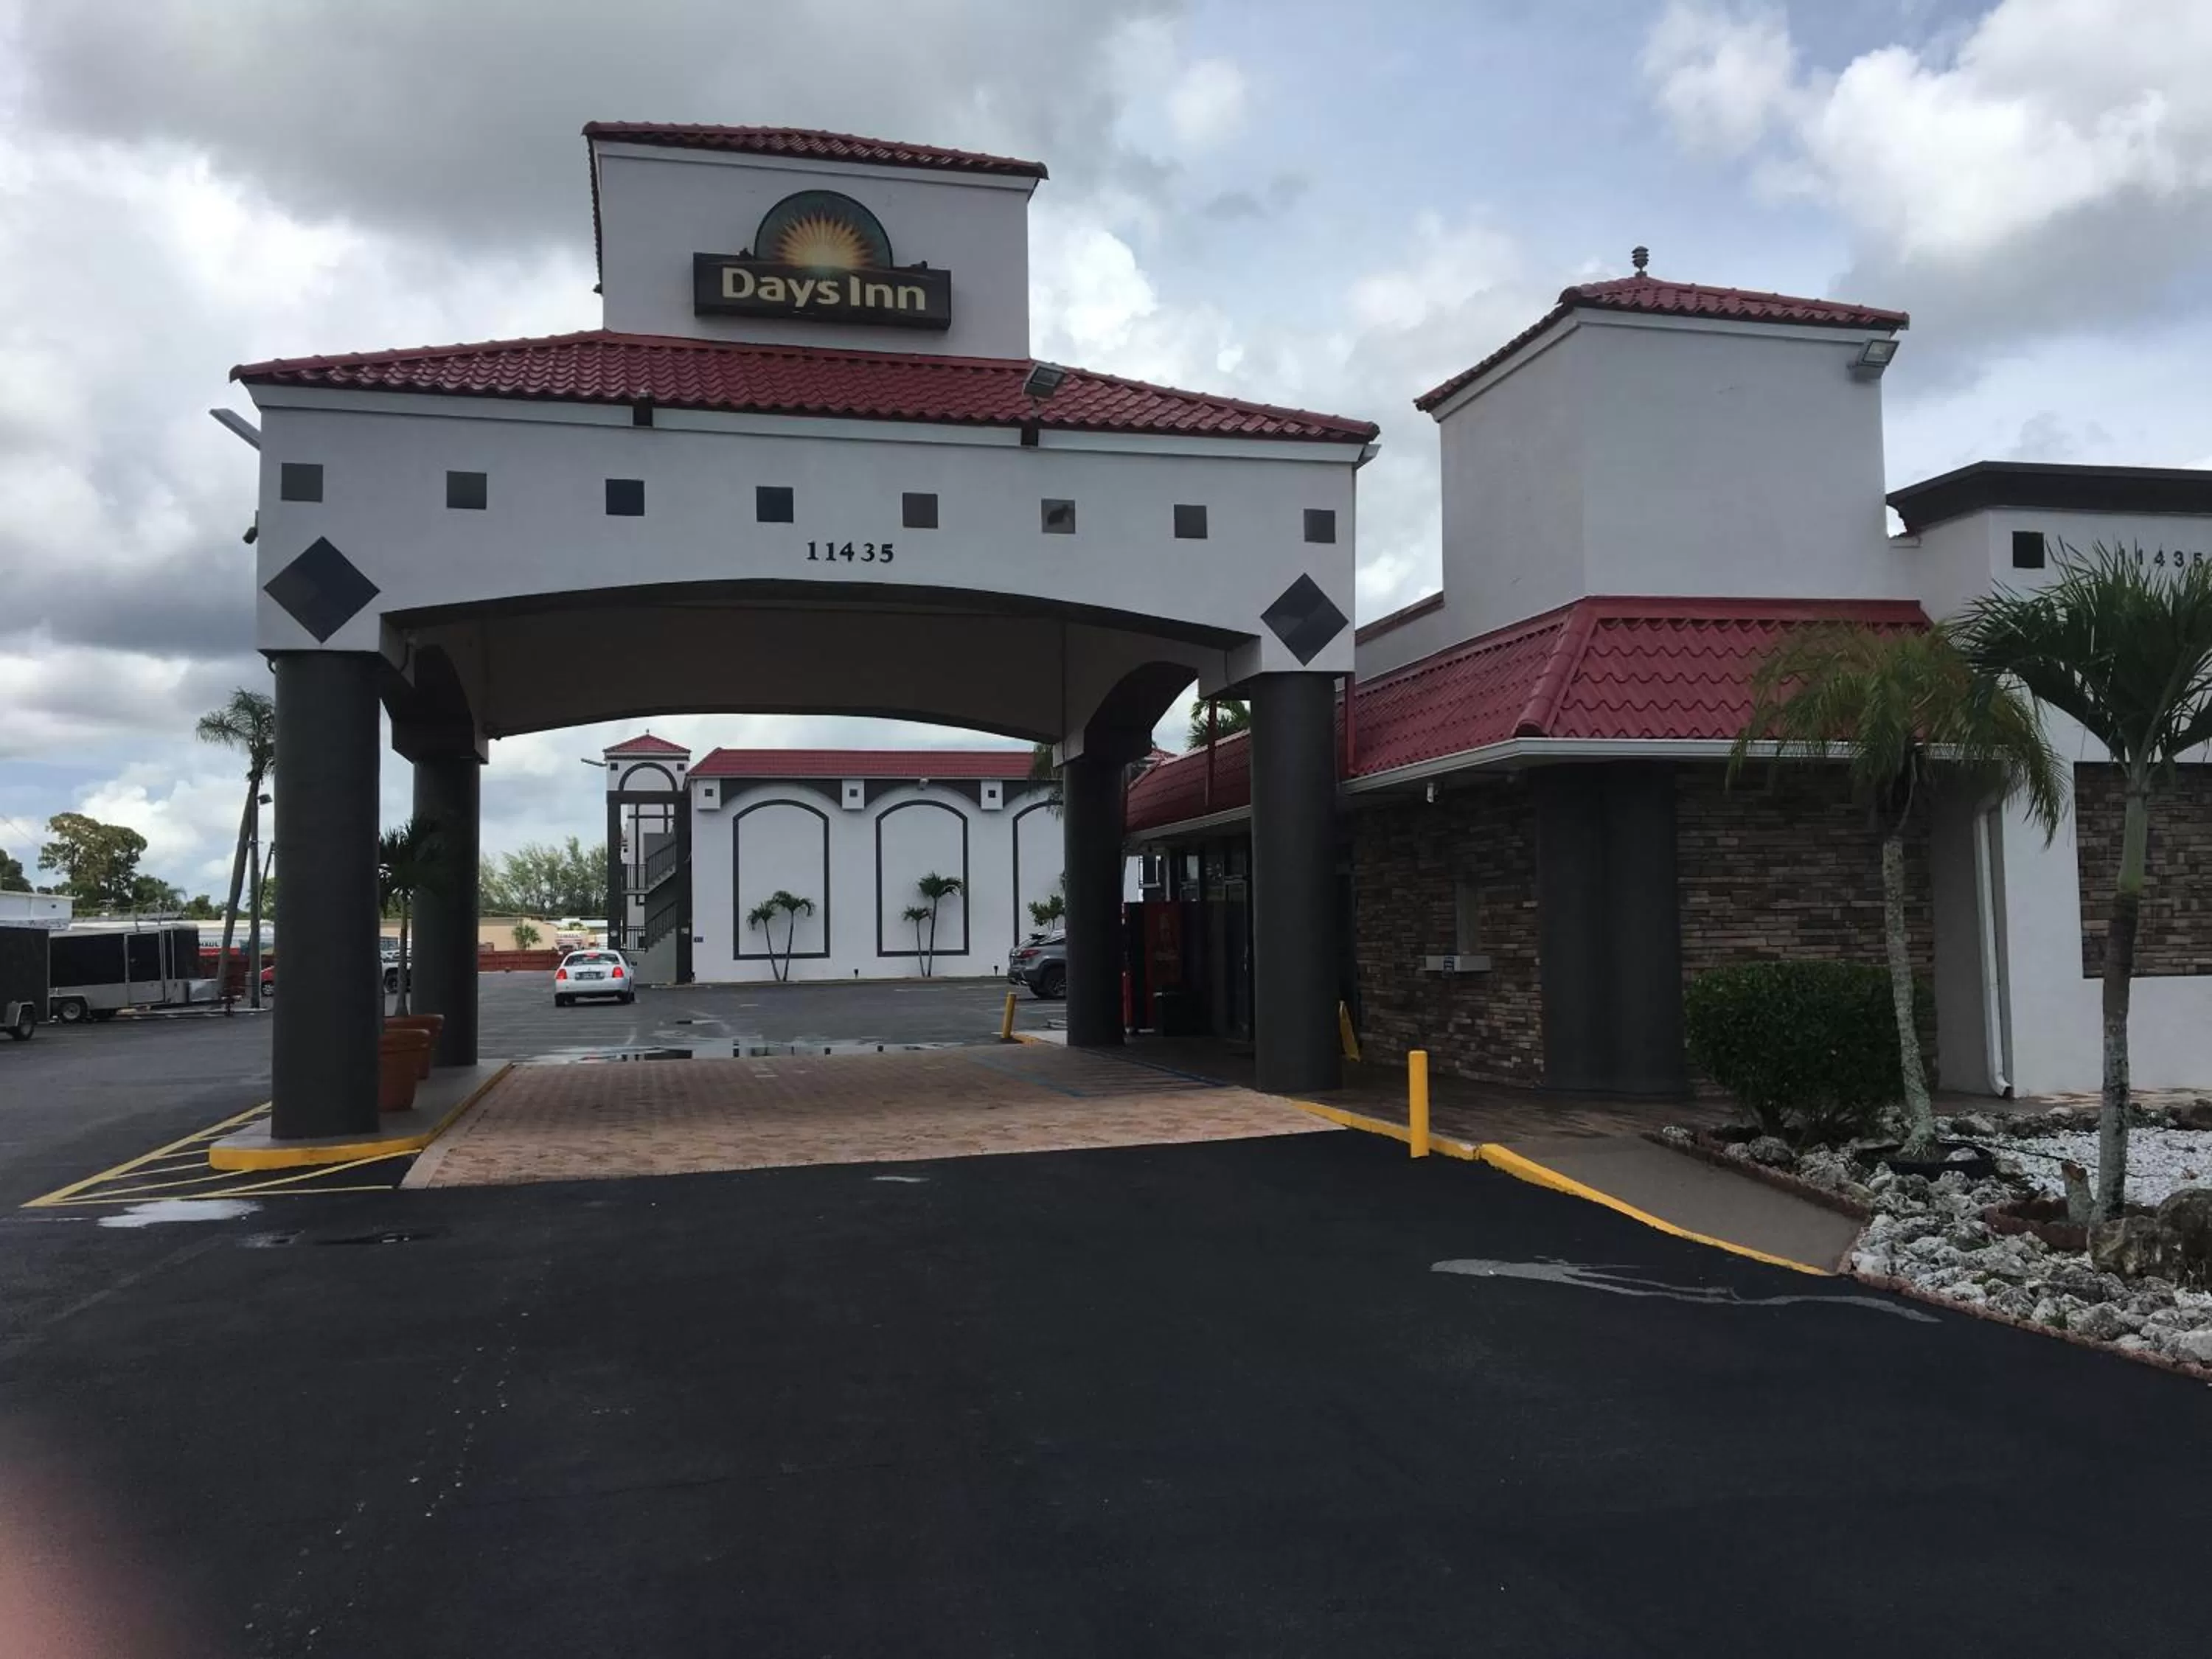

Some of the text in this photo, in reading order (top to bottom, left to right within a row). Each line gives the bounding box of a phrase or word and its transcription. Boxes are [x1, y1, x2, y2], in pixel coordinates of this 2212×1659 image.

[722, 267, 926, 310] Days Inn
[807, 540, 894, 563] 11435
